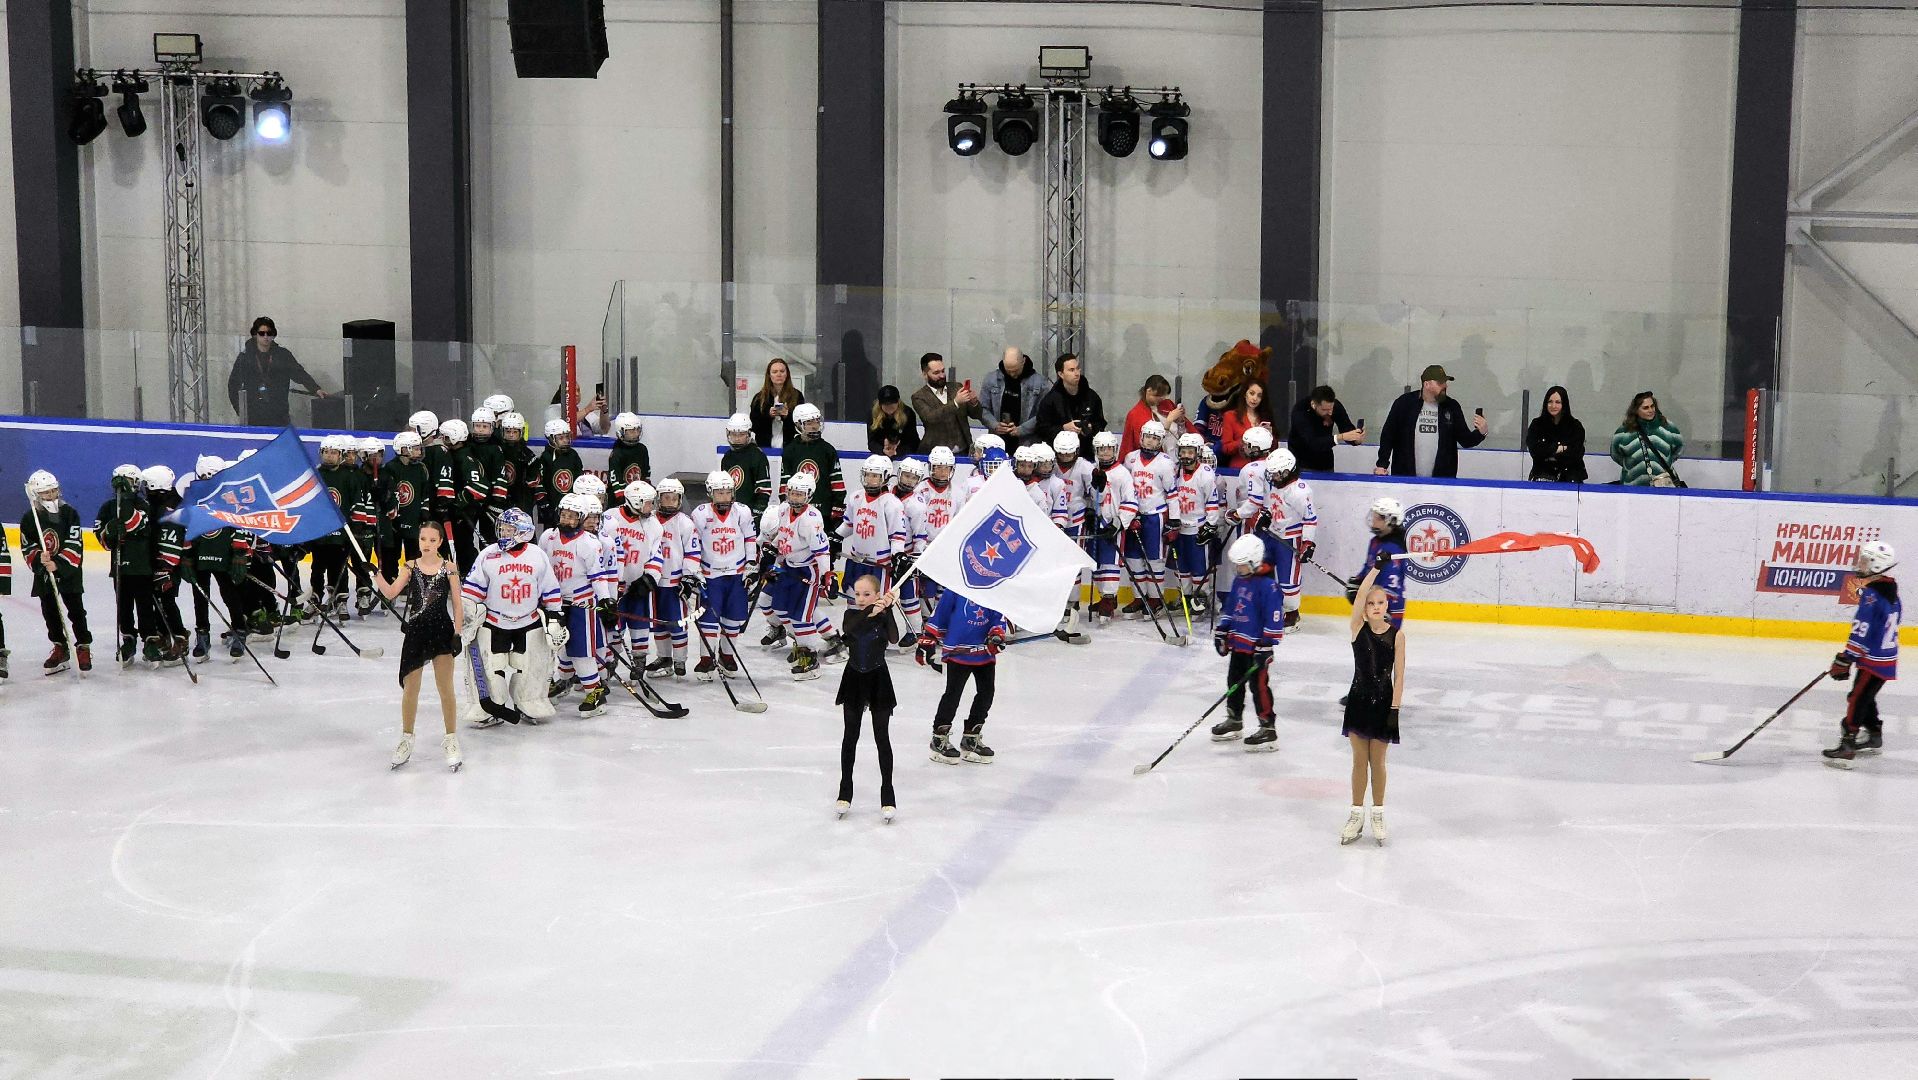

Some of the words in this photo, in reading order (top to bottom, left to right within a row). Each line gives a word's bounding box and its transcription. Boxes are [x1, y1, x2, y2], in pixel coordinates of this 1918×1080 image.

[471, 471, 480, 481] 5
[1403, 508, 1445, 528] АКАДЕМИЯ
[1446, 515, 1461, 530] СКА
[161, 529, 177, 543] 34
[711, 527, 736, 535] АРМИЯ
[992, 518, 1022, 553] СКА
[1776, 523, 1856, 542] КРАСНАЯ
[713, 540, 735, 555] СКА
[1771, 541, 1861, 567] МАШИН
[498, 563, 533, 576] АРМИЯ
[1773, 569, 1836, 588] ЮНИОР
[1387, 574, 1398, 588] 3
[501, 583, 532, 605] СКА
[1852, 619, 1870, 638] 29
